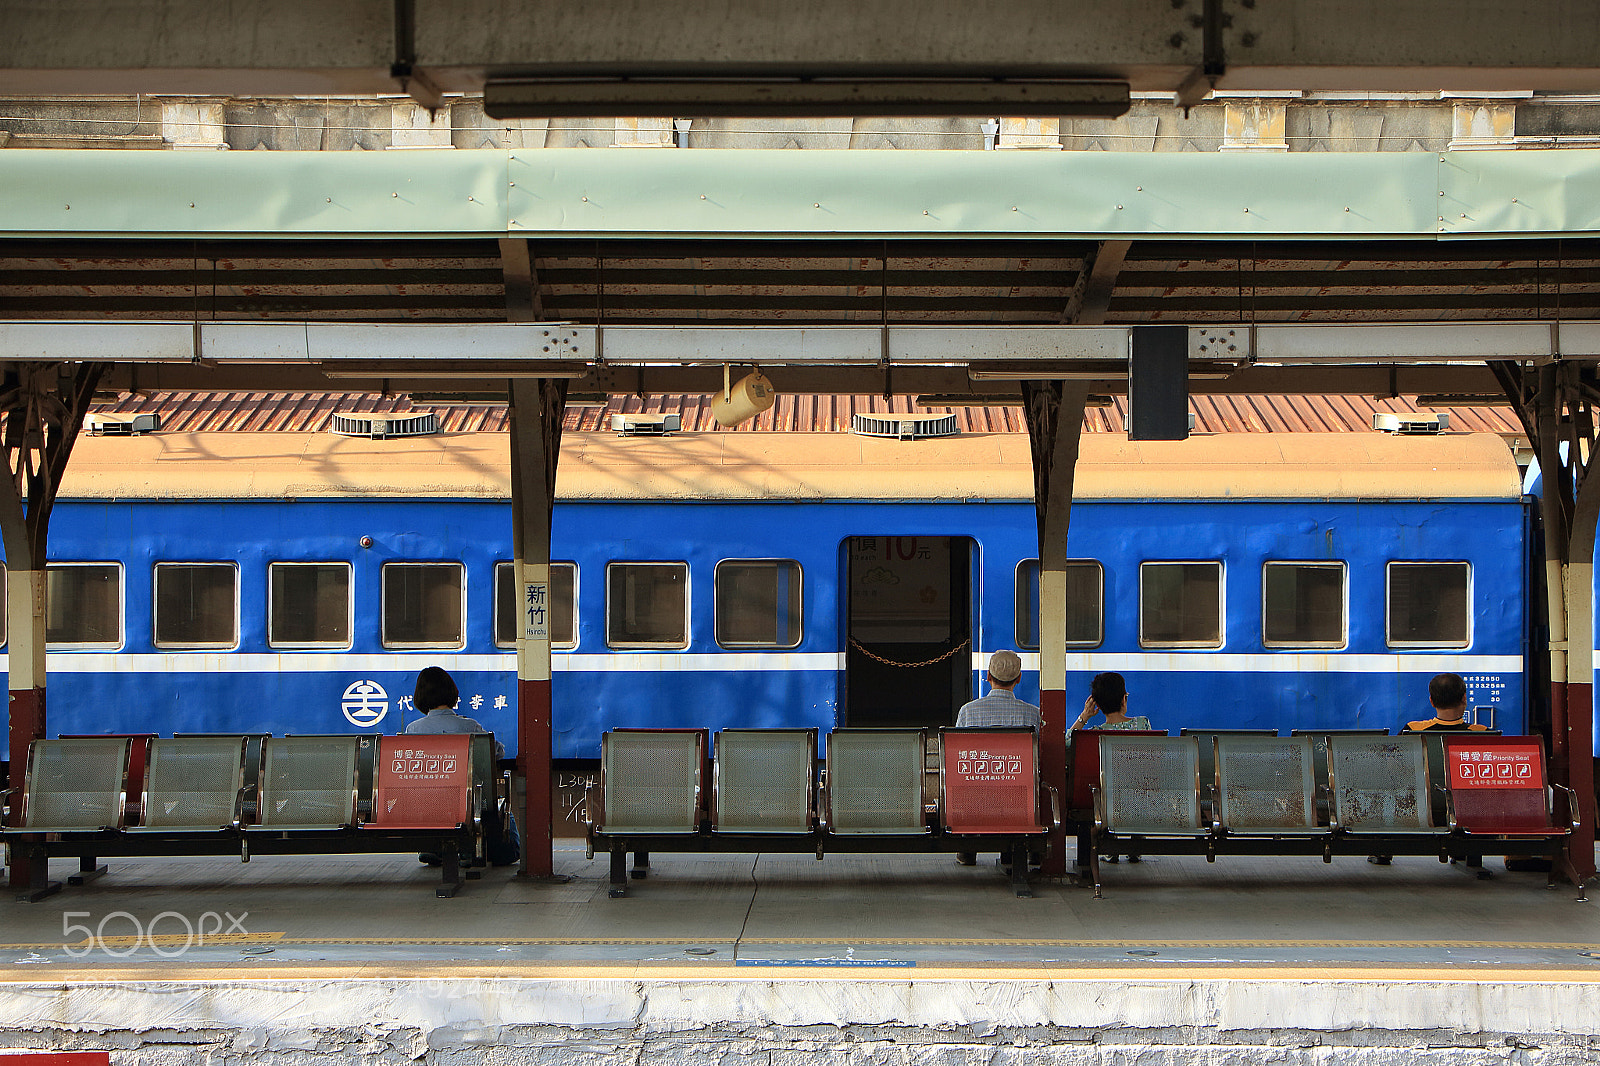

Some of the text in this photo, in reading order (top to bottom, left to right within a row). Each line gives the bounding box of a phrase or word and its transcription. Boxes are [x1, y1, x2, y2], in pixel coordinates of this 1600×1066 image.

[918, 547, 931, 559] 元
[527, 585, 546, 625] 新竹
[394, 749, 424, 759] 博愛座
[958, 750, 988, 760] 博愛座
[1460, 751, 1492, 761] 博愛座
